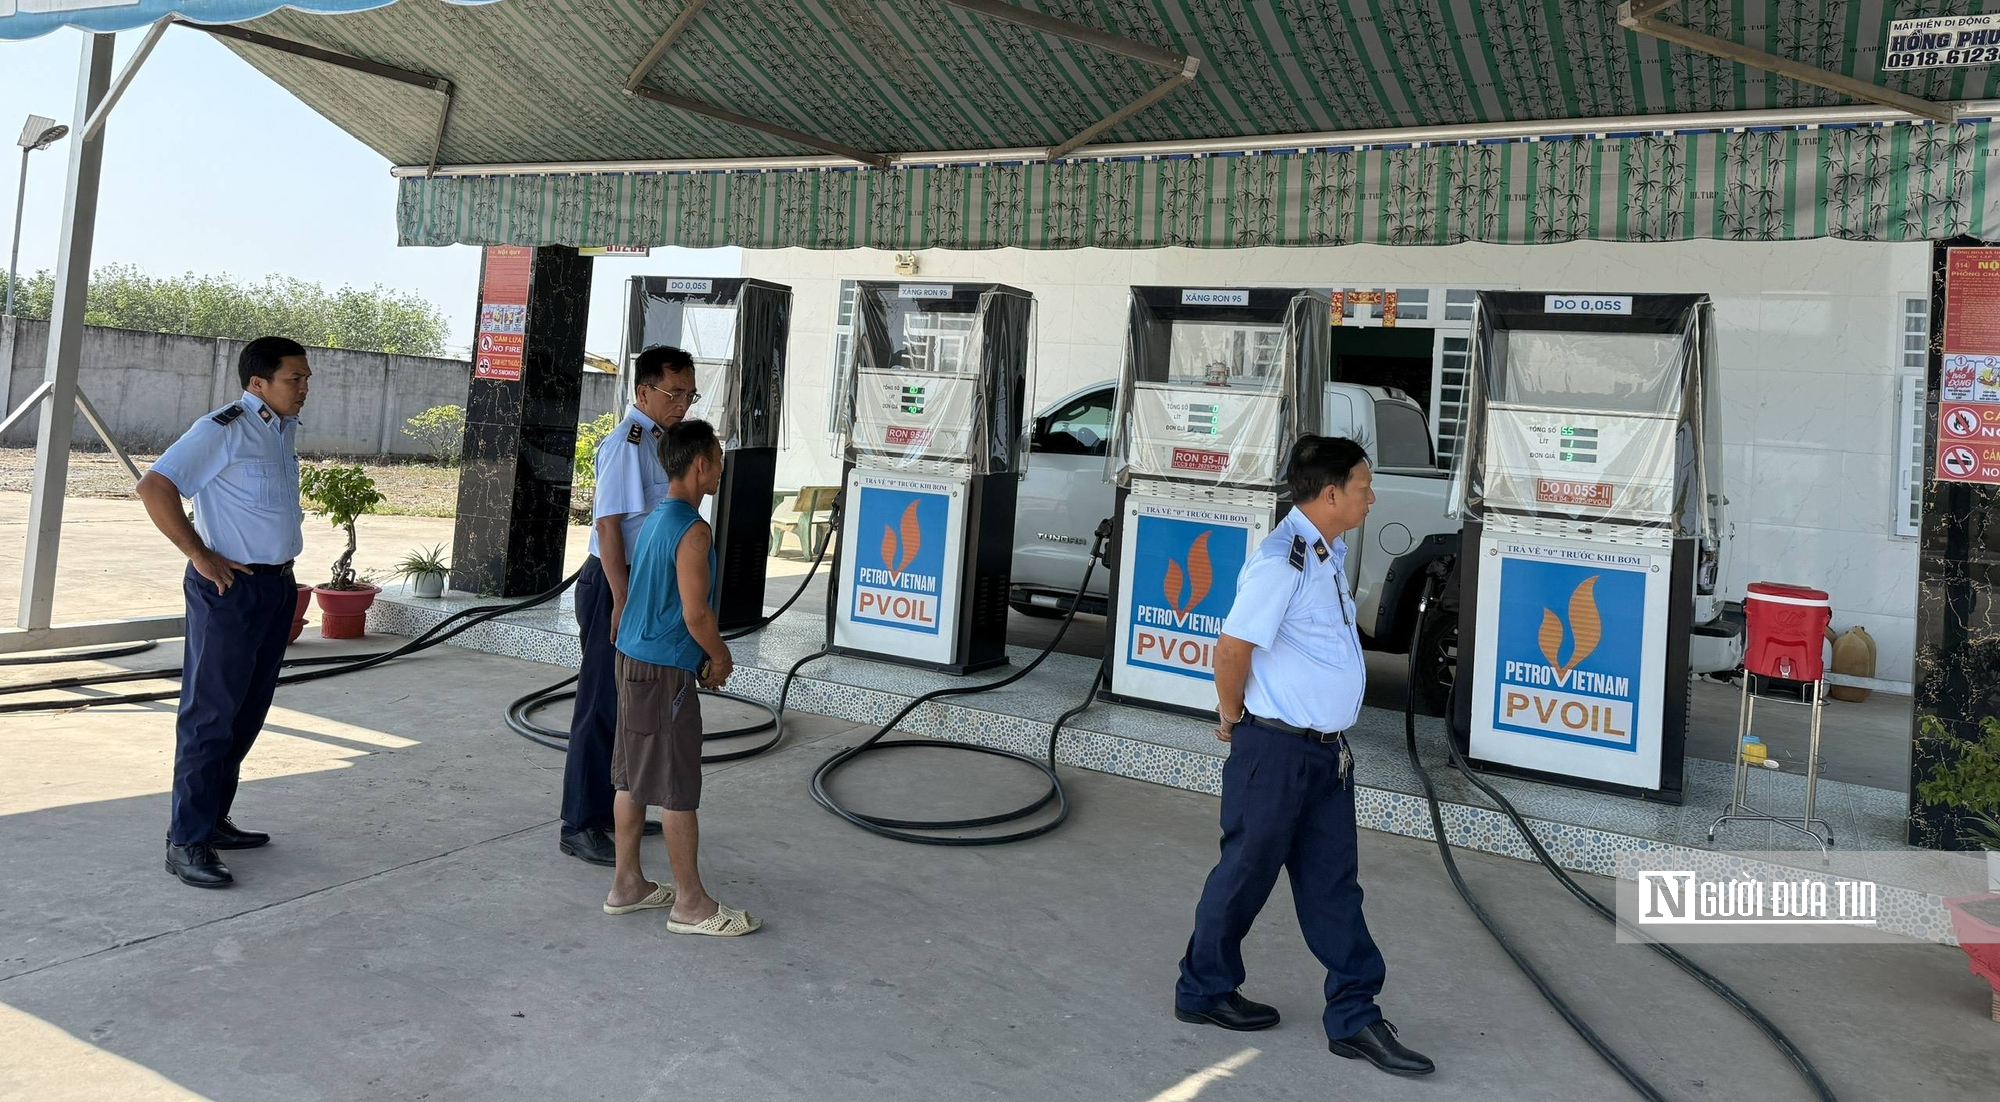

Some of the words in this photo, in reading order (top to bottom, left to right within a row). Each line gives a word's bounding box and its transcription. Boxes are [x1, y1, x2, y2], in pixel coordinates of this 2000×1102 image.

[1894, 22, 1912, 30] MÁI
[1945, 19, 1955, 27] DI
[1958, 16, 1990, 26] ĐỘNG
[1890, 29, 1952, 52] HỒNG
[1888, 48, 2000, 67] 0918.6123
[686, 282, 707, 290] 0,05S
[1186, 293, 1210, 302] XĂNG
[1554, 300, 1576, 310] DO
[1581, 300, 1622, 311] 0,05S
[889, 429, 908, 438] RON
[1176, 452, 1199, 462] RON
[1545, 450, 1555, 459] GIÁ
[1982, 468, 2000, 476] NO
[1541, 482, 1560, 493] DO
[1563, 484, 1608, 498] 0.05S-II
[1506, 544, 1526, 554] TRẢ
[1528, 545, 1542, 555] VỀ
[1561, 549, 1595, 560] TRƯỚC
[1597, 553, 1616, 562] KHI
[1617, 555, 1641, 564] BƠM
[860, 568, 936, 592] PETROVIETNAM
[859, 592, 932, 622] PVOIL
[1138, 605, 1226, 635] PETROVIETNA
[1137, 633, 1215, 668] PVOI
[1505, 660, 1629, 696] PETROVIETNAM
[1506, 692, 1625, 736] PVOIL
